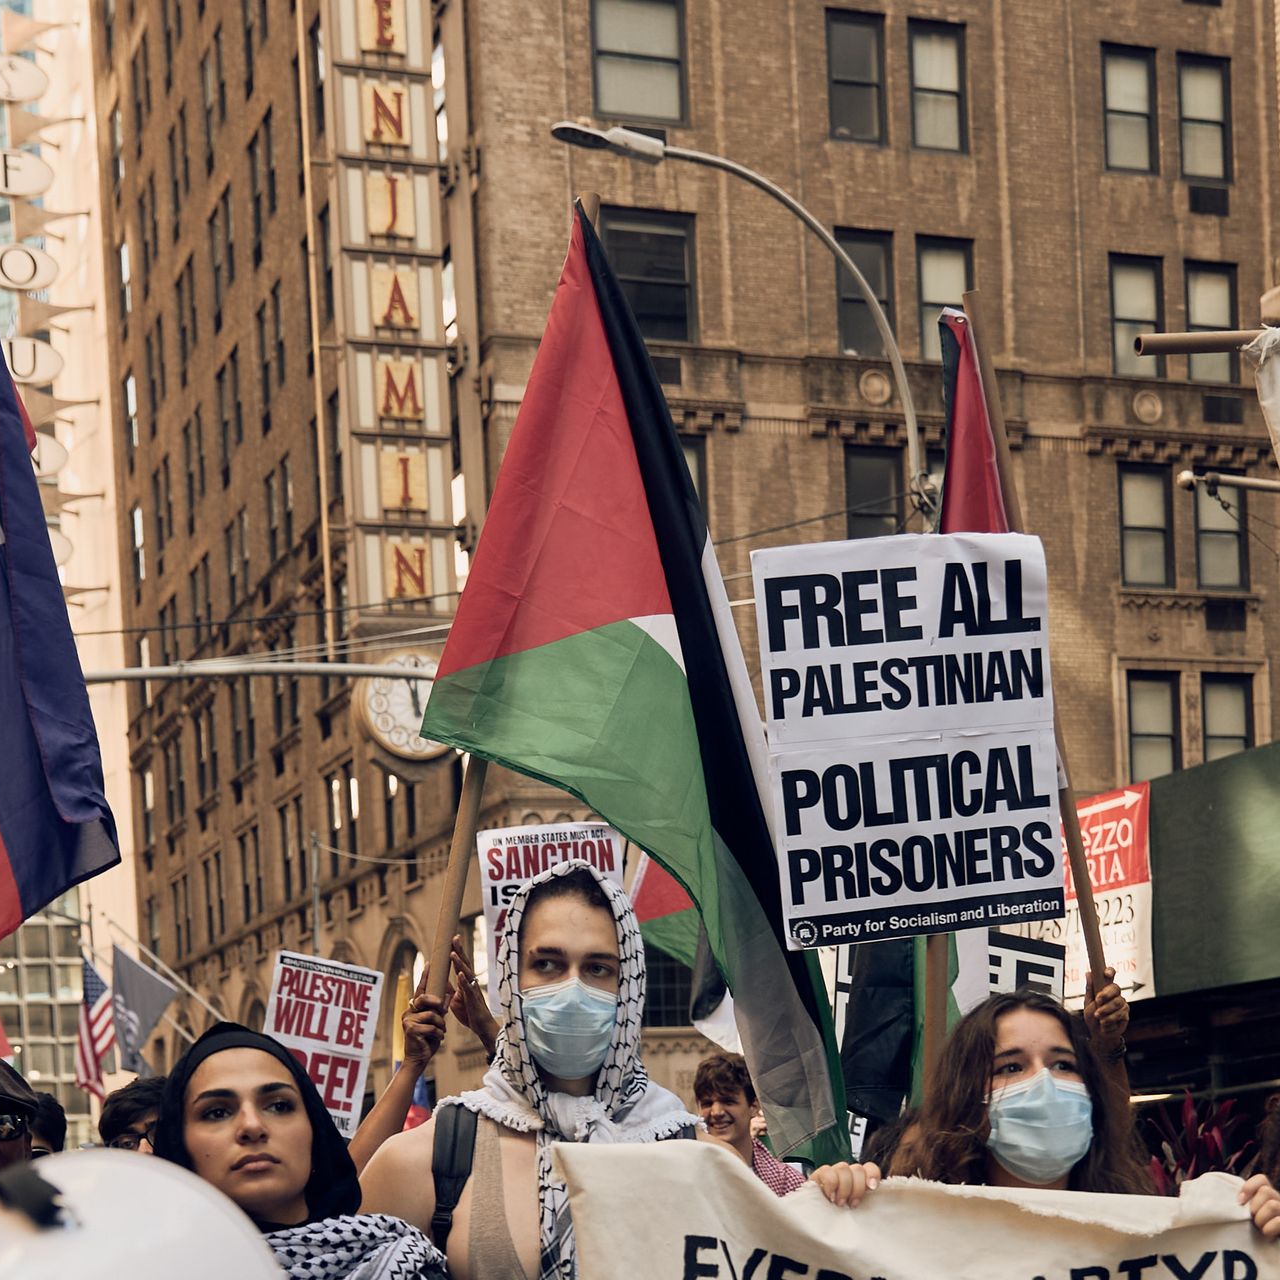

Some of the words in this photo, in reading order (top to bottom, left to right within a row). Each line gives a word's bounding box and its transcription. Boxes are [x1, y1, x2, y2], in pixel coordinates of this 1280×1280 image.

[764, 566, 922, 653] FREE
[938, 559, 1041, 639] ALL
[770, 647, 1045, 720] PALESTINIAN
[781, 744, 1051, 836] POLITICAL
[505, 834, 539, 845] MEMBER
[541, 831, 568, 843] STATES
[569, 830, 589, 840] MUST
[787, 821, 1056, 906] PRISONERS
[822, 921, 861, 938] Party
[864, 918, 886, 933] for
[888, 911, 958, 930] Socialism
[960, 906, 984, 921] and
[988, 900, 1060, 918] Liberation
[277, 966, 373, 1013] PALESTINE
[273, 996, 330, 1042] WILL
[335, 1009, 369, 1050] BE
